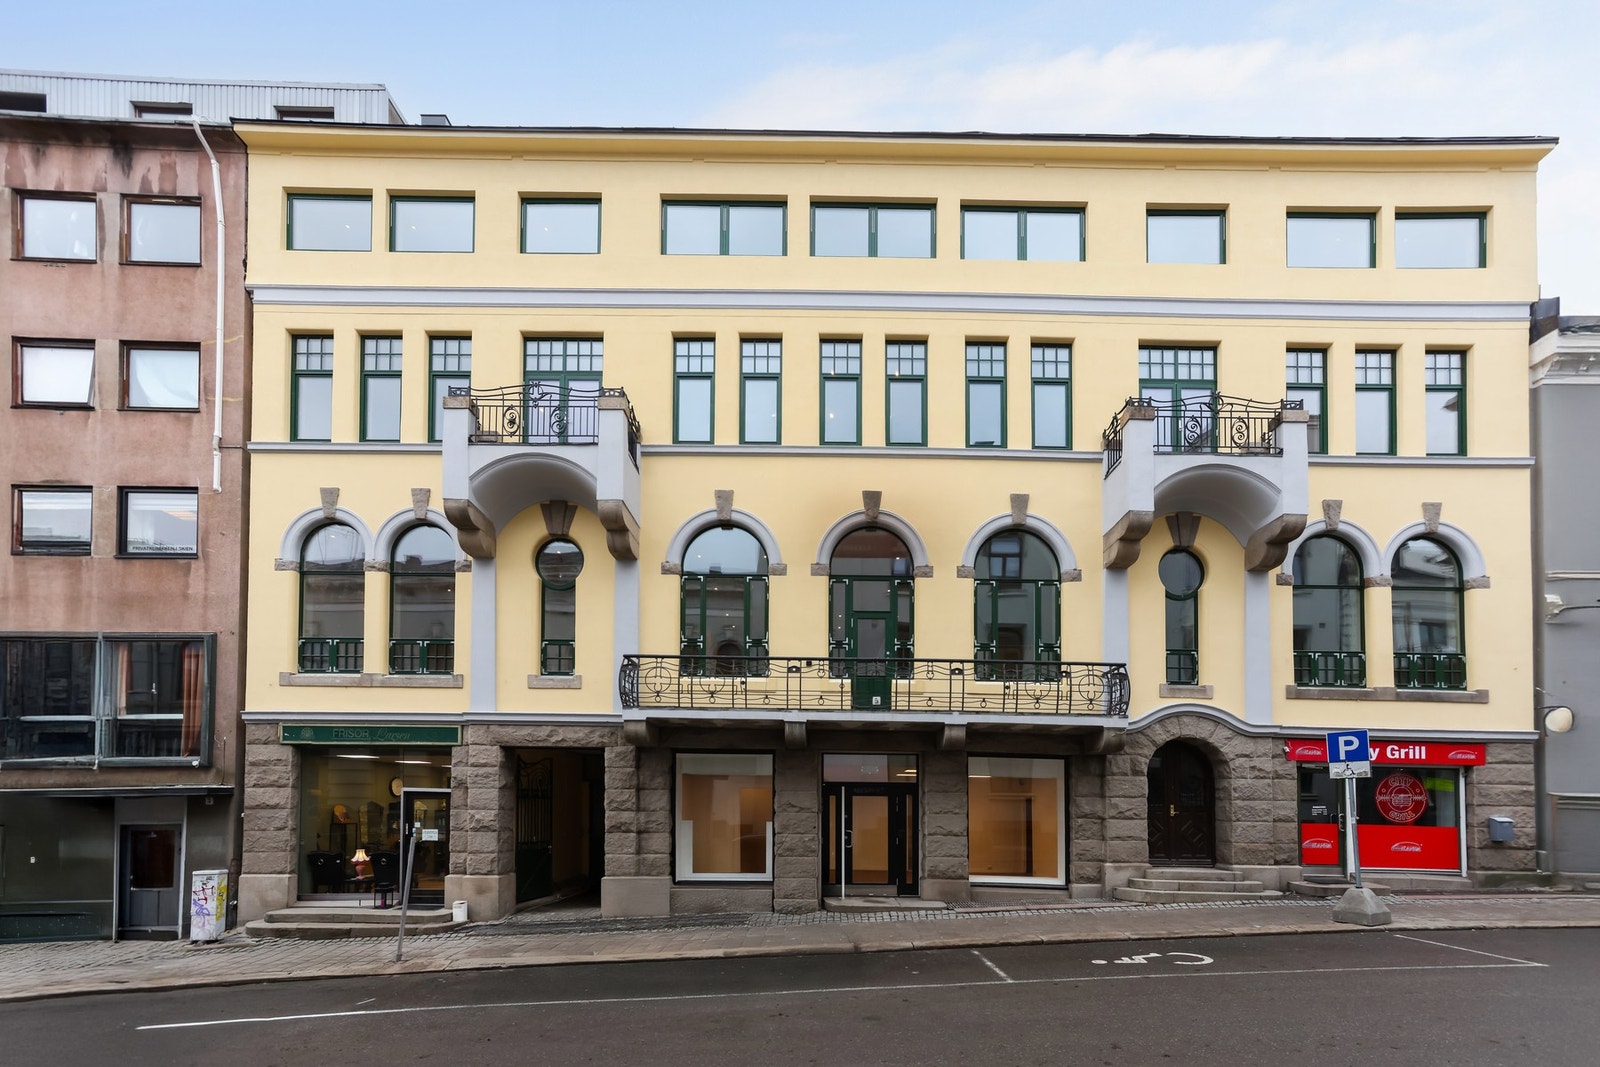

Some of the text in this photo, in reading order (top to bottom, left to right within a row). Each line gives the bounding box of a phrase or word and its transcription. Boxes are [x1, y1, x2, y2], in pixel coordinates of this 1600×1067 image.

[1338, 735, 1360, 760] P
[1386, 745, 1426, 759] Grill
[1389, 777, 1413, 787] CITY
[1388, 810, 1416, 821] GRILL
